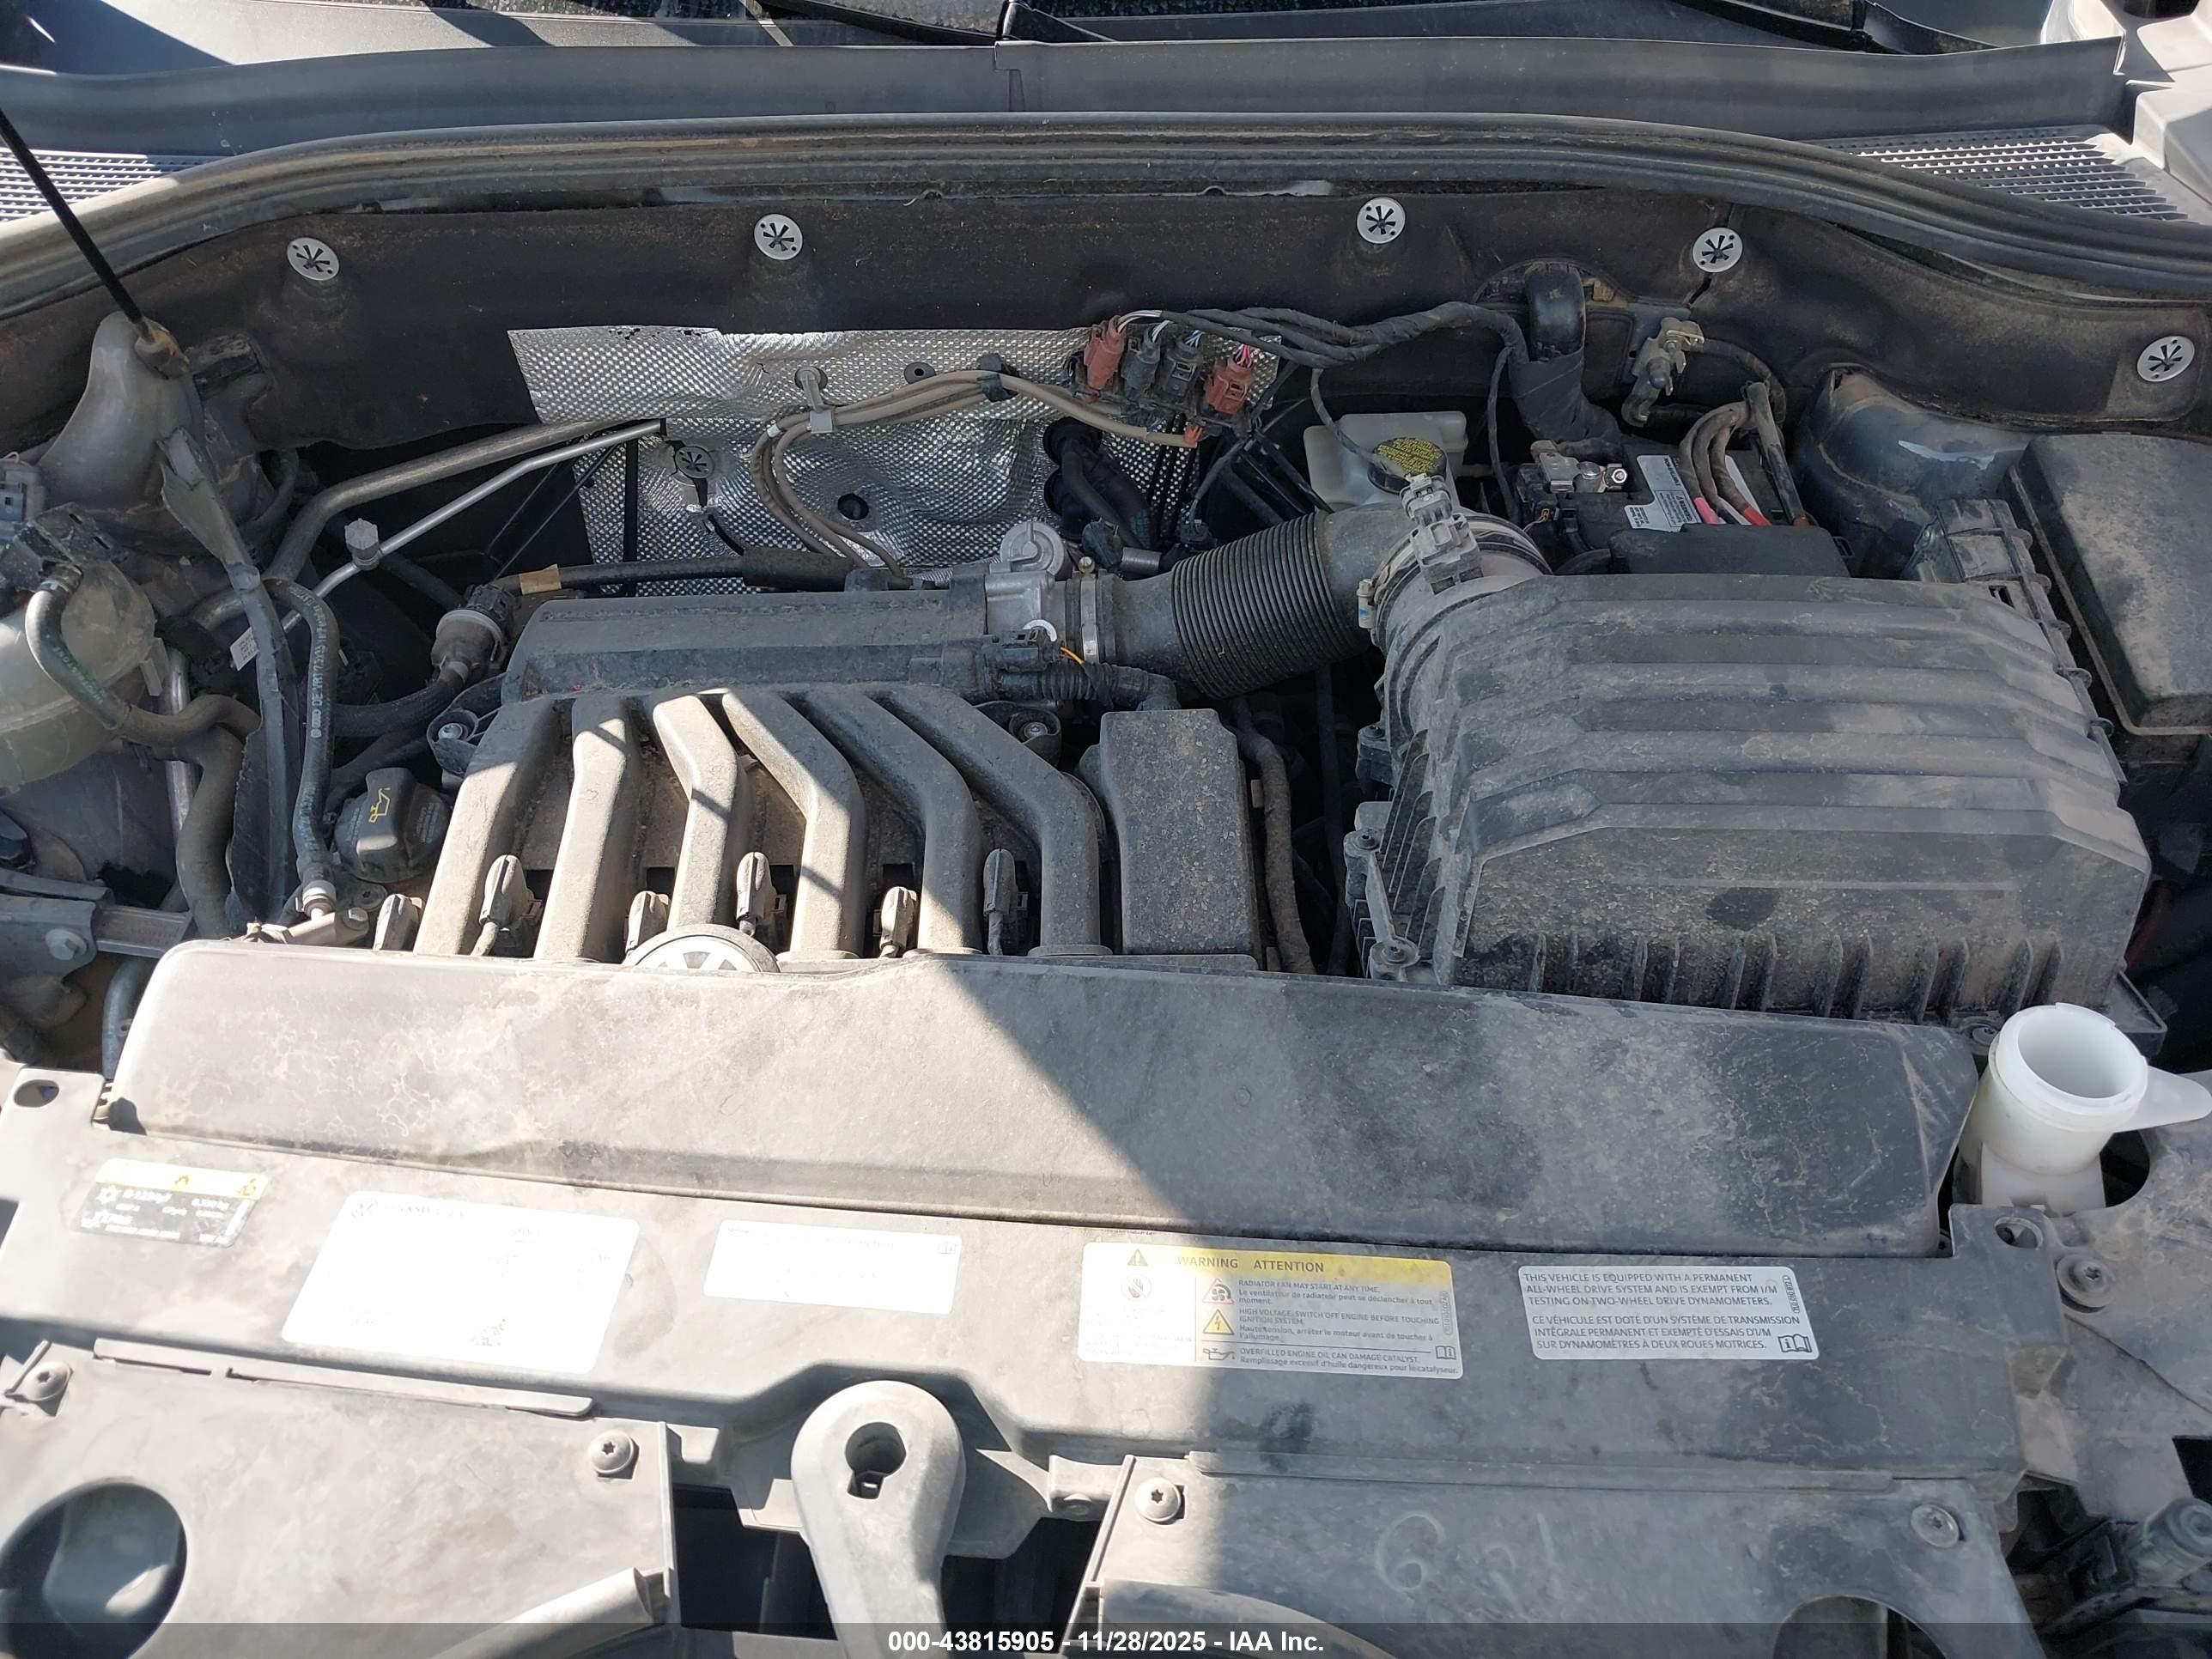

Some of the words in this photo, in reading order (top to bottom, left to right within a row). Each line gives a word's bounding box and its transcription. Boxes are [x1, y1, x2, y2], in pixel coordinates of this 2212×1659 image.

[1177, 1256, 1238, 1268] WARNING
[1254, 1260, 1324, 1272] ATTENTION
[1603, 1273, 1652, 1283] EQUIPPED
[1656, 1273, 1681, 1282] WITH
[1692, 1273, 1753, 1282] PERMANENT
[1528, 1297, 1570, 1305] TESTING
[1573, 1297, 1589, 1305] ON
[1590, 1297, 1654, 1305] TWO-WHEEL
[1656, 1297, 1686, 1305] DRIVE
[1688, 1297, 1772, 1305] DYNAMOMETERS.
[1370, 1314, 1399, 1322] BEFORE
[1401, 1316, 1439, 1324] TOUCHING
[1532, 1316, 1544, 1324] CE
[1546, 1314, 1594, 1324] VÉHICULE
[1596, 1316, 1613, 1324] EST
[1615, 1314, 1643, 1324] DOTÉ
[1644, 1316, 1668, 1324] D'UN
[1671, 1315, 1713, 1324] SYSTÈME
[1728, 1316, 1800, 1324] TRANSMISSION
[1534, 1327, 1587, 1336] INTÉGRALE
[1662, 1327, 1704, 1336] EXEMPTÉ
[1705, 1328, 1745, 1336] D'ESSAIS
[1559, 1339, 1640, 1348] DYNAMOMÈTRES
[1643, 1338, 1649, 1348] À
[1651, 1340, 1679, 1349] DEUX
[1681, 1340, 1714, 1349] ROUES
[1716, 1340, 1765, 1349] MOTRICES.
[1240, 1348, 1285, 1357] OVERFILLED
[1348, 1361, 1388, 1370] dangereux
